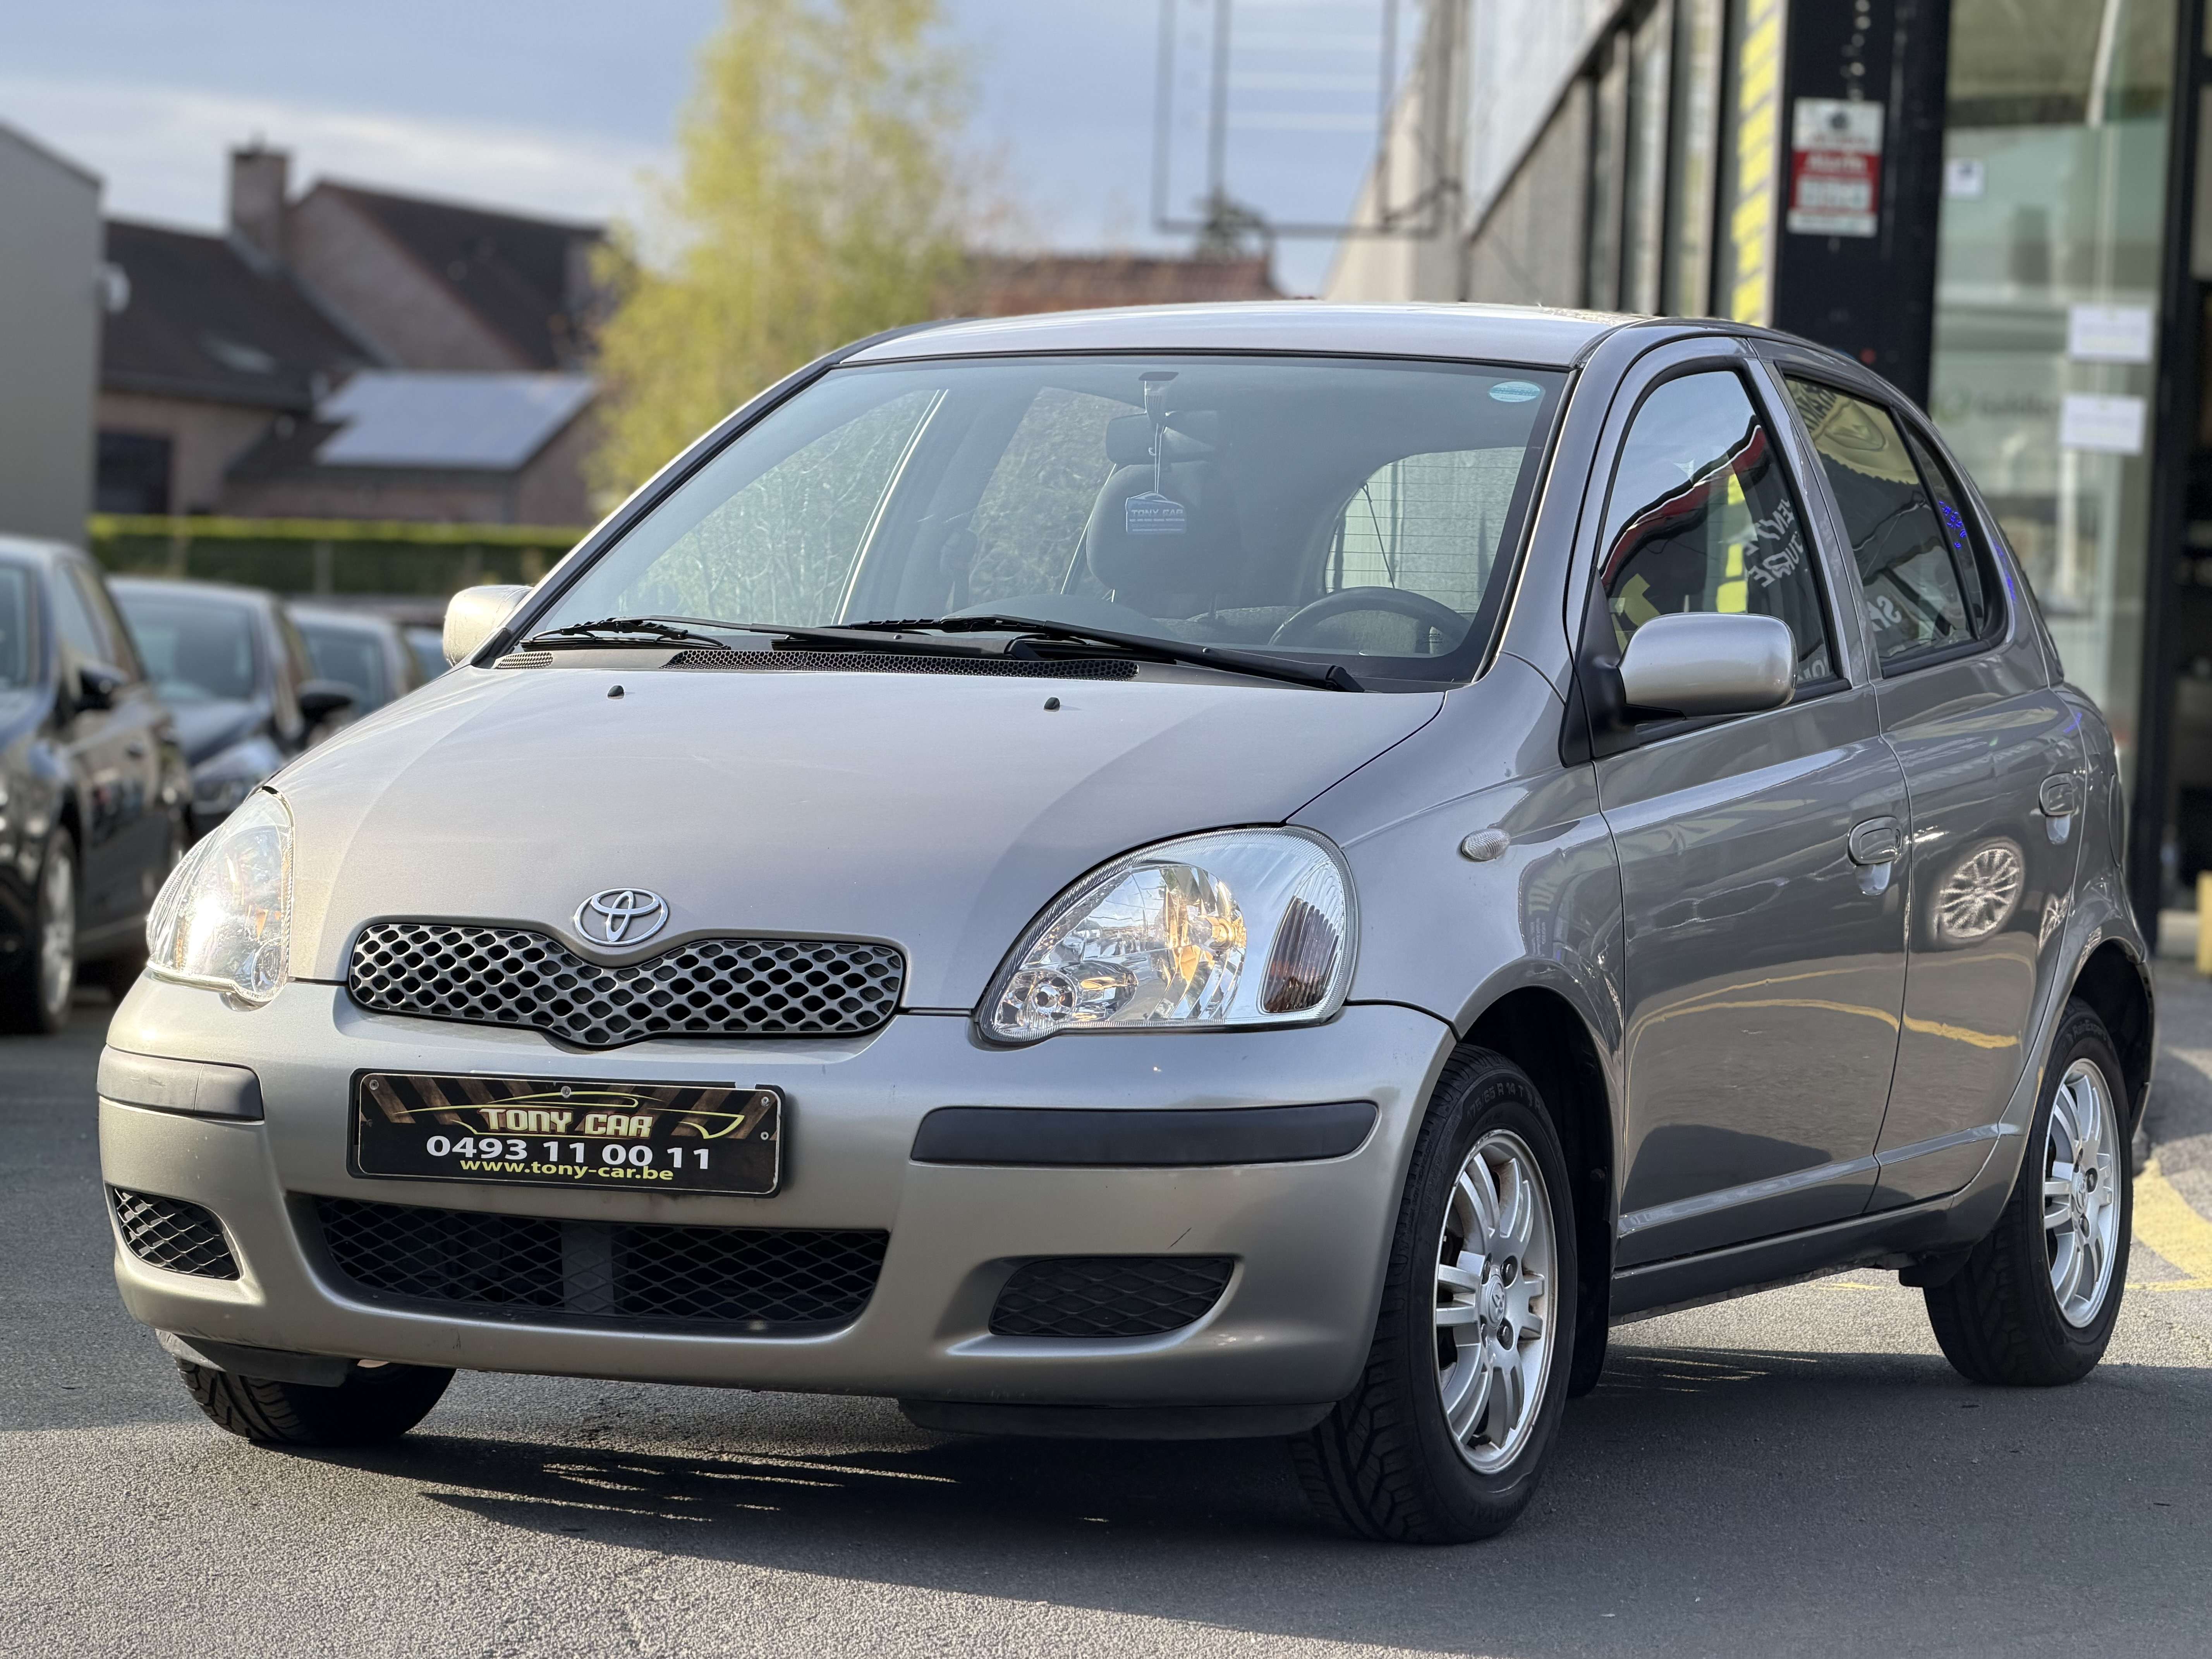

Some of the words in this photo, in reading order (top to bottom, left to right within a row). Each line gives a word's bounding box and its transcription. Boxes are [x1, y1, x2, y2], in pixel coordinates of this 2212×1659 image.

[478, 1108, 573, 1133] TONY
[584, 1113, 654, 1138] CAR
[426, 1135, 528, 1160] 0493
[543, 1141, 585, 1163] 11
[602, 1144, 653, 1166] 00
[667, 1147, 709, 1170] 11
[460, 1160, 674, 1180] www.tony-car.be
